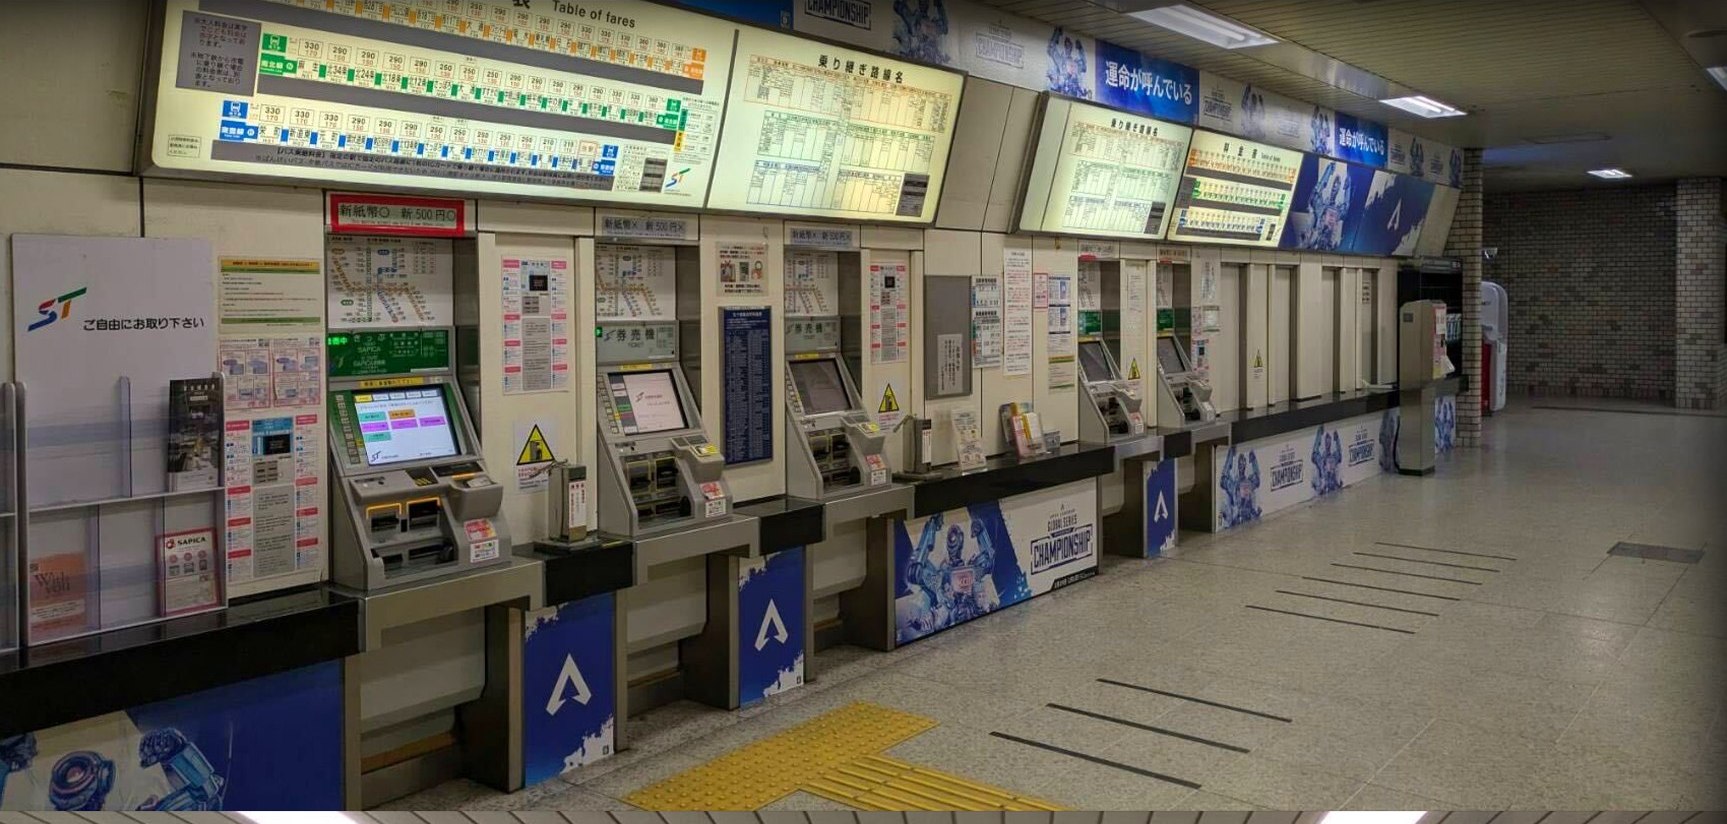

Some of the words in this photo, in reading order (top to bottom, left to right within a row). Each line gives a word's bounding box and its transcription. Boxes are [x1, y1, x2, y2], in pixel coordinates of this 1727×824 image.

[552, 0, 586, 18] Table
[590, 10, 602, 21] of
[606, 12, 636, 29] fares
[304, 42, 319, 50] 330
[818, 54, 903, 84] 乗り継ぎ路線名
[1106, 61, 1192, 105] 運命が呼んでいる
[264, 108, 280, 116] 330
[294, 110, 310, 118] 330
[324, 114, 339, 122] 330
[352, 117, 366, 125] 290
[1339, 127, 1384, 156] 運命が呼んでいる
[83, 317, 205, 332] ご自由にお取り下さい
[177, 536, 206, 546] SAPICA
[1034, 530, 1090, 569] CHAMPIONSHIP
